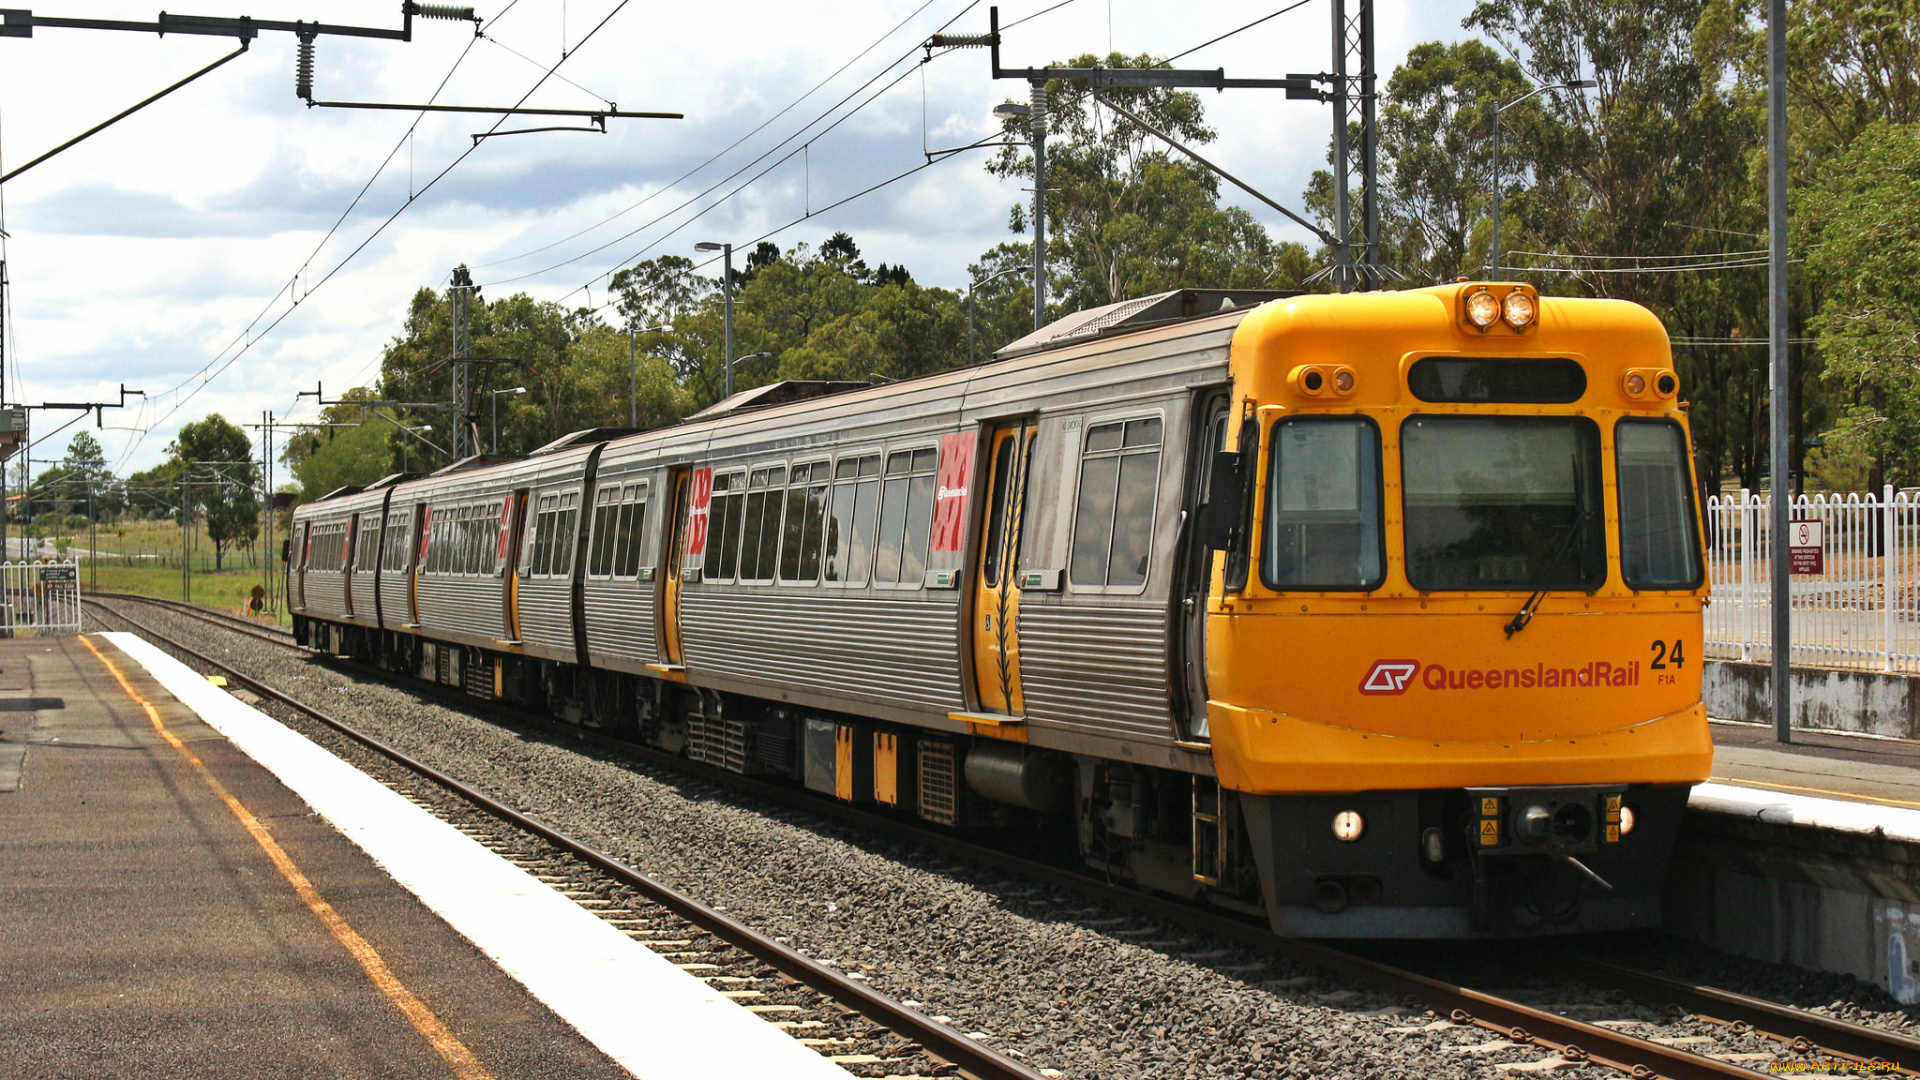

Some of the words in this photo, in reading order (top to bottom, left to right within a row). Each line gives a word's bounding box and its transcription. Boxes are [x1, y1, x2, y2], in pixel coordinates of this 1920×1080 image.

[1650, 639, 1685, 670] 24
[1422, 660, 1639, 691] QueenslandRail
[1657, 674, 1676, 686] F1A
